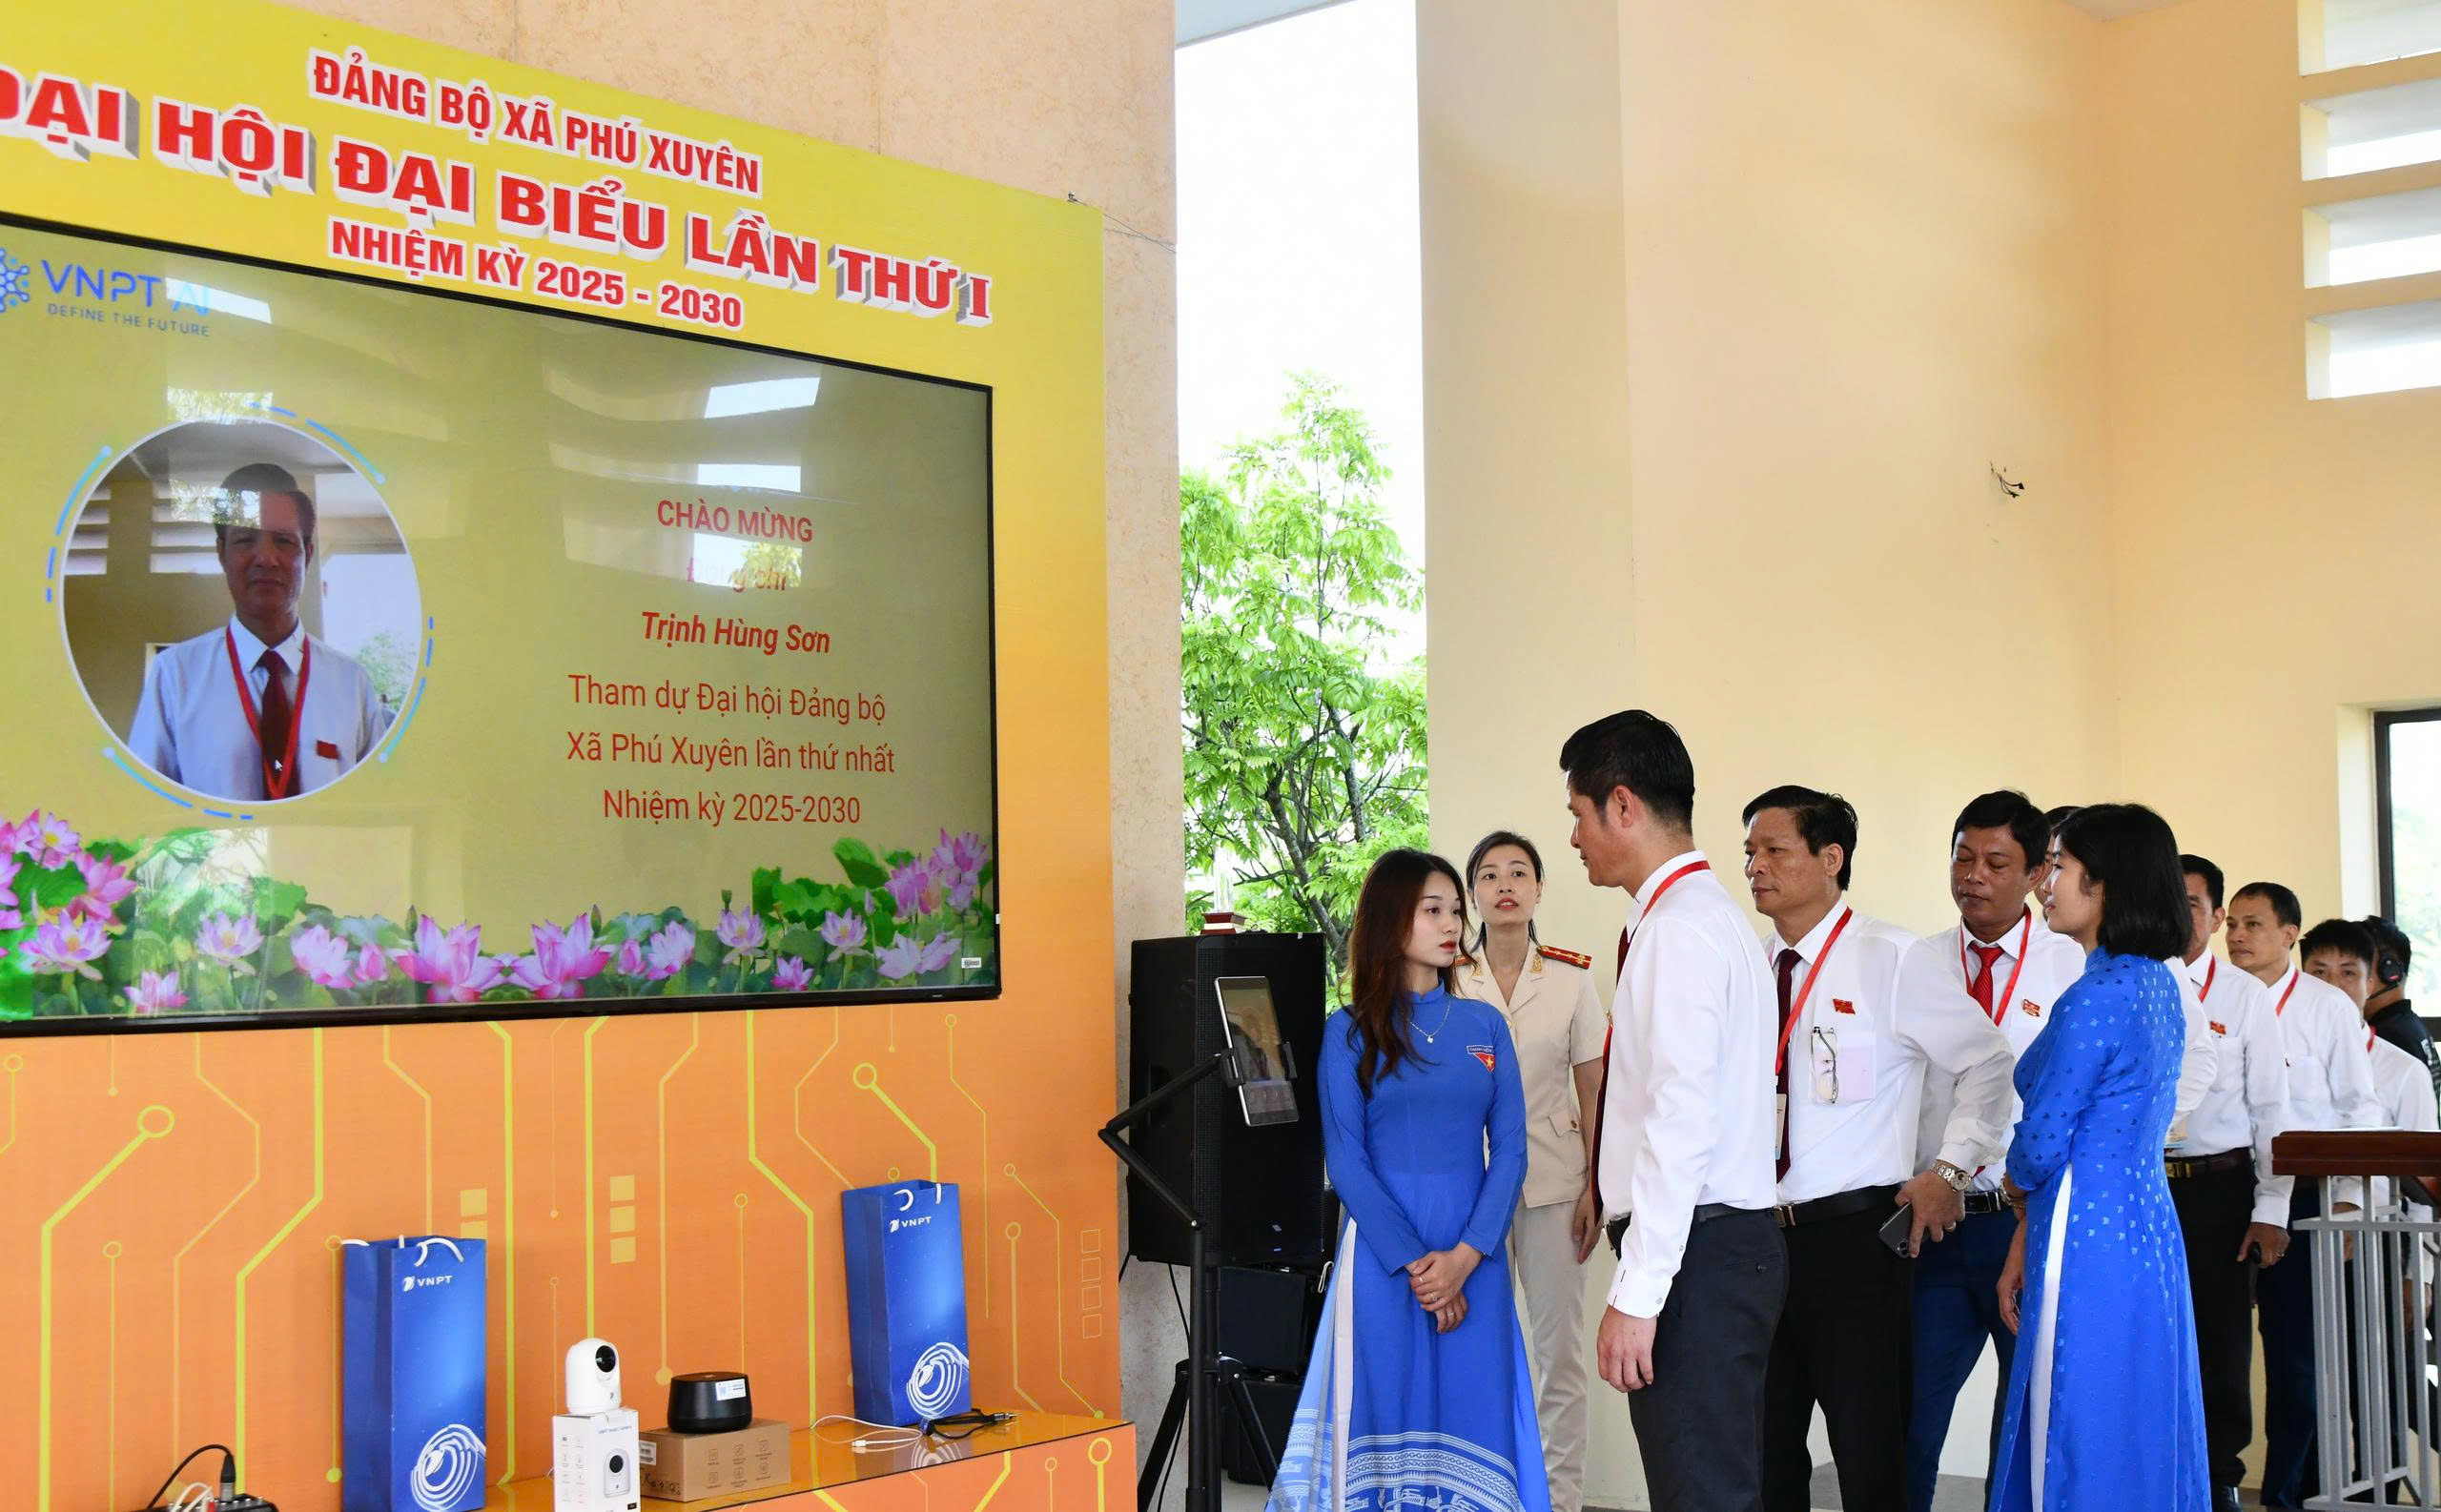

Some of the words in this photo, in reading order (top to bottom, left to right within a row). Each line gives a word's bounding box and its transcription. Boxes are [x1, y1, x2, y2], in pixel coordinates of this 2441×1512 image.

[313, 51, 427, 118] ĐẢNG
[440, 86, 492, 139] BỘ
[503, 100, 555, 147] XÃ
[564, 113, 638, 165] PHÚ
[648, 133, 760, 194] XUYÊN
[156, 101, 306, 183] HỘI
[334, 140, 471, 216] ĐẠI
[499, 174, 667, 251] BIỂU
[690, 215, 819, 285] LẦN
[836, 248, 958, 310] THỨ
[972, 276, 990, 319] I
[41, 258, 162, 308] VNPT
[330, 220, 464, 277] NHIỆM
[476, 246, 525, 288] KỲ
[536, 260, 626, 307] 2025
[660, 283, 743, 328] 2030
[48, 302, 105, 323] DEFINE
[112, 312, 142, 328] THE
[148, 317, 210, 337] FUTURE
[657, 498, 730, 533] CHÀO
[738, 505, 814, 542] MỪNG
[641, 610, 707, 649] Trịnh
[714, 617, 779, 657] Hùng
[785, 623, 831, 655] Sơn
[567, 673, 647, 707] Tham
[655, 679, 690, 715] dự
[696, 682, 738, 718] Đại
[746, 684, 782, 721] hội
[789, 686, 851, 725] Đảng
[858, 692, 886, 726] bộ
[566, 730, 603, 762] Xã
[611, 733, 664, 764] Phú
[670, 736, 748, 773] Xuyên
[755, 737, 791, 769] lần
[798, 742, 839, 771] thứ
[845, 743, 895, 774] nhất
[603, 788, 689, 825] Nhiệm
[697, 791, 726, 828] kỳ
[732, 793, 862, 825] 2025-2030
[901, 1216, 932, 1228] VNPT
[417, 1275, 454, 1287] VNPT
